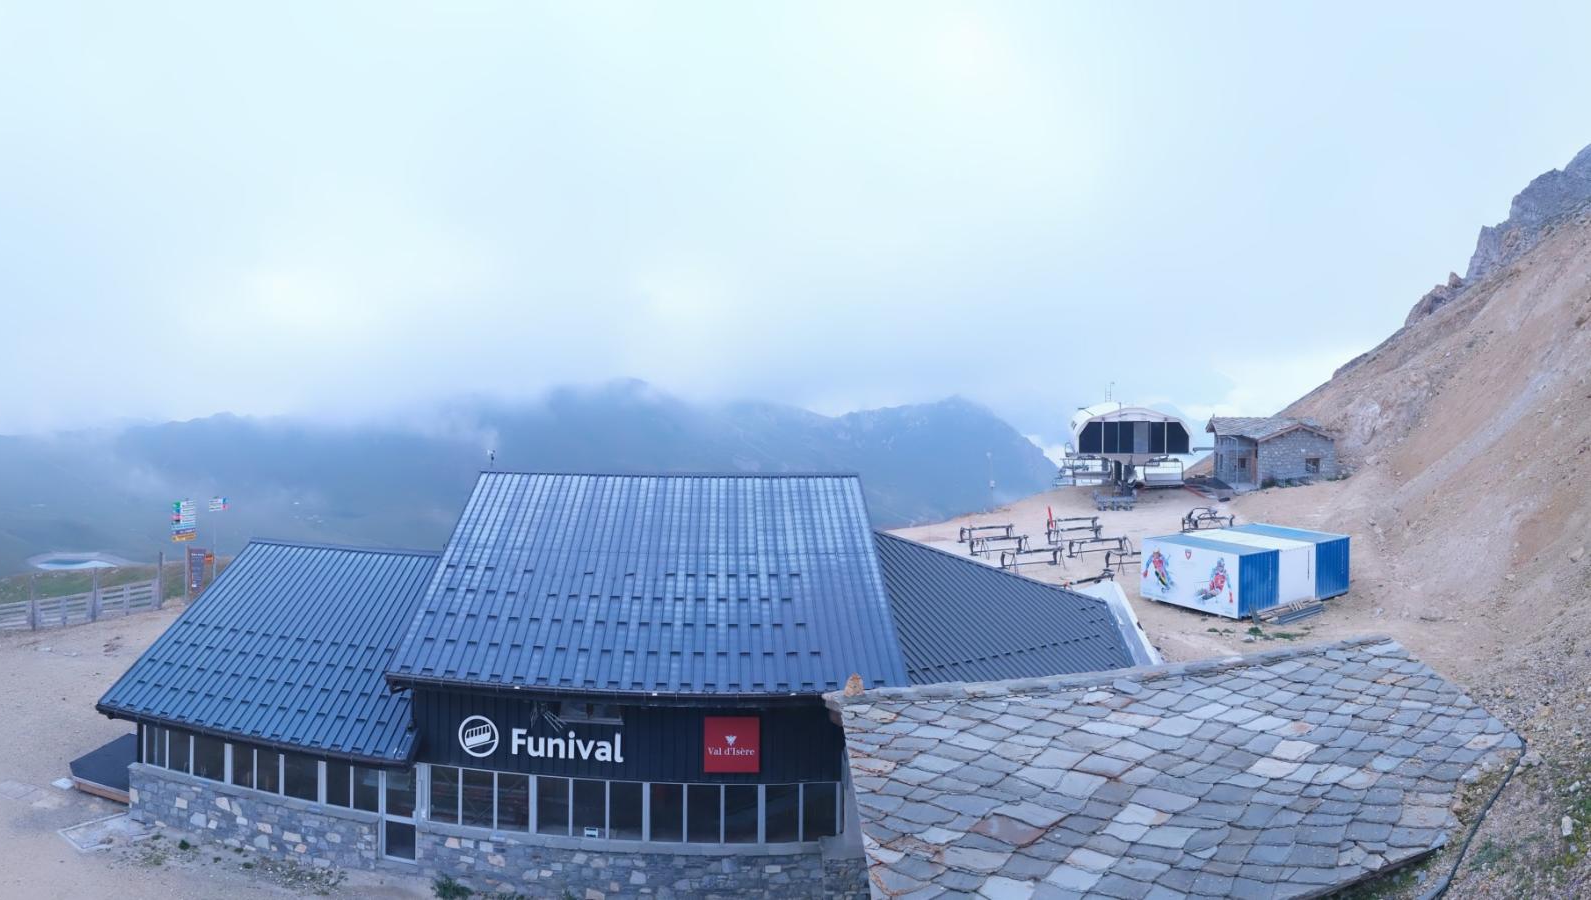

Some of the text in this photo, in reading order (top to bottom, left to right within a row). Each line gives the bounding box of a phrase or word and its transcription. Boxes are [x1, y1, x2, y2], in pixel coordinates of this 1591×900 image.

[511, 728, 624, 763] Funival
[708, 746, 755, 756] Val d'Isère
